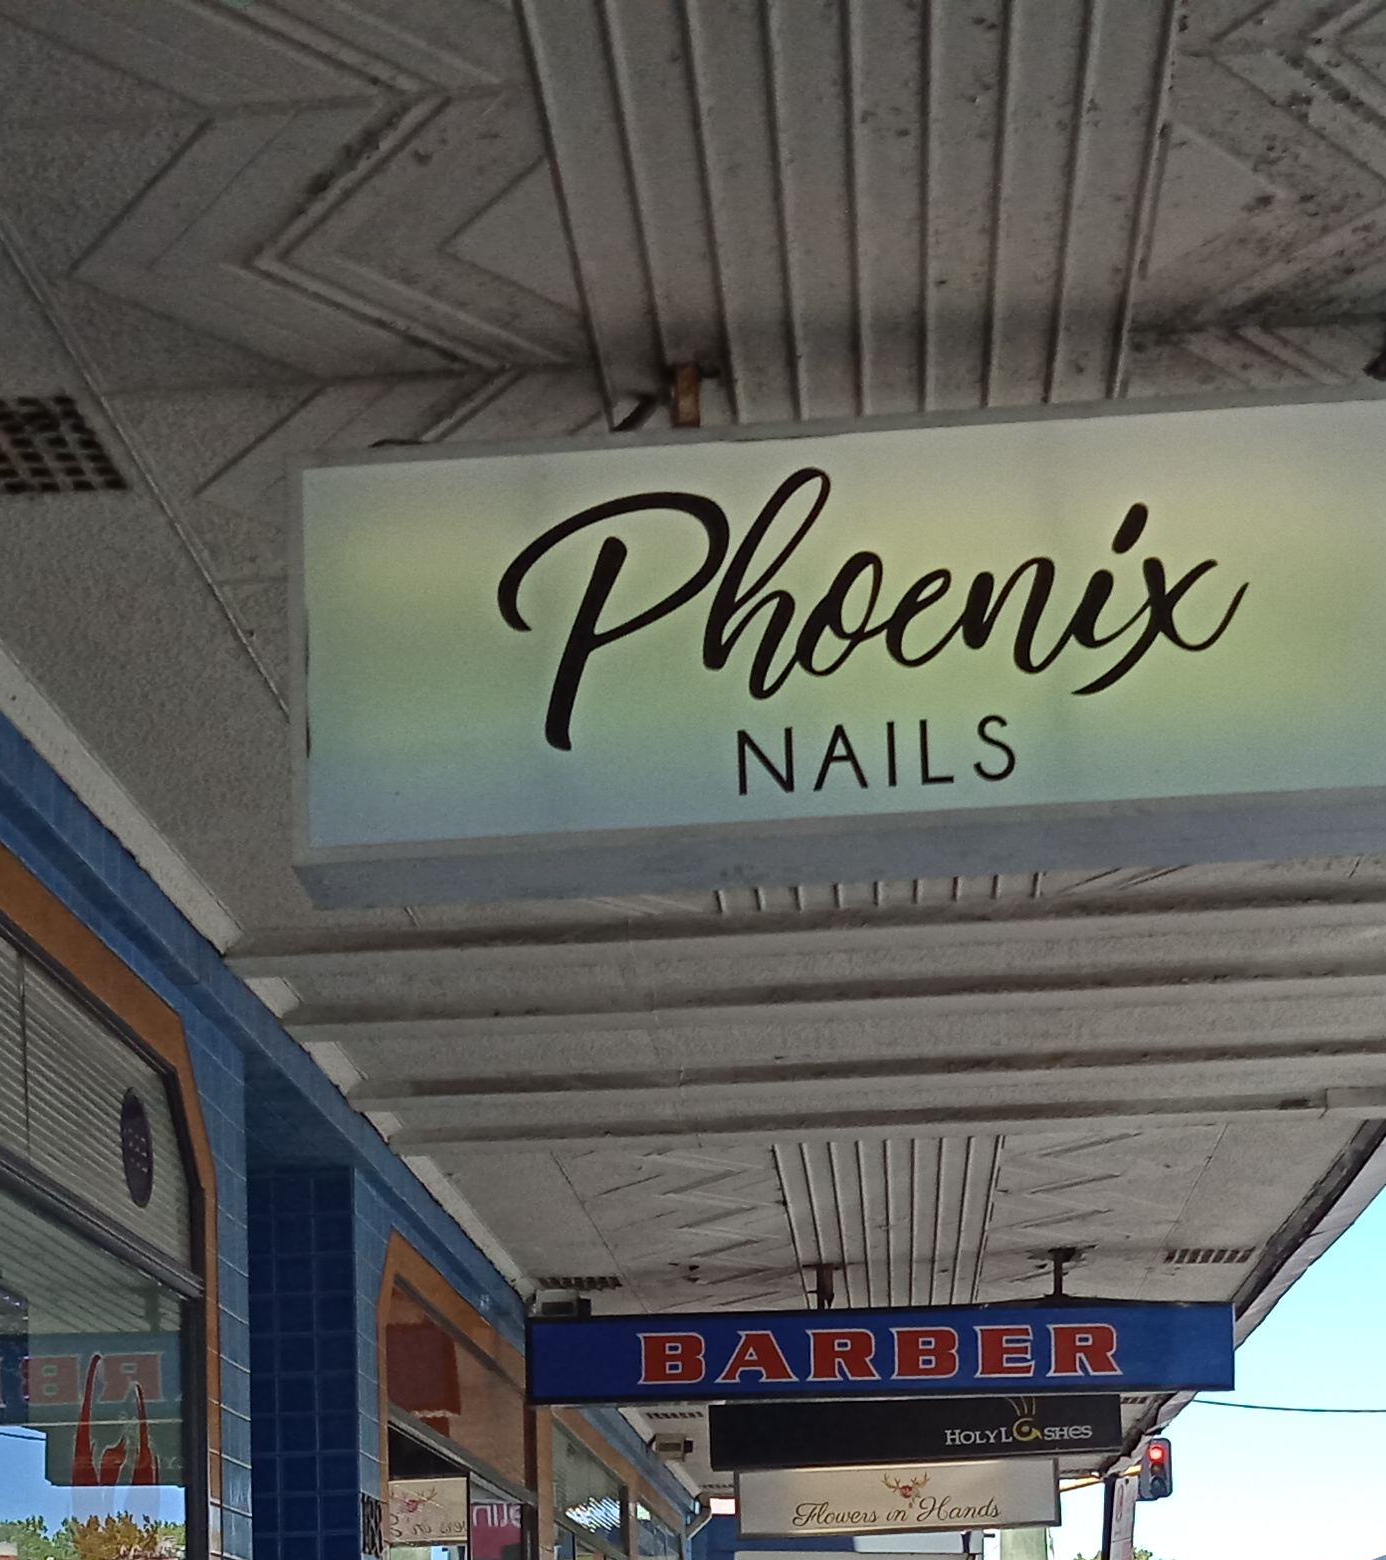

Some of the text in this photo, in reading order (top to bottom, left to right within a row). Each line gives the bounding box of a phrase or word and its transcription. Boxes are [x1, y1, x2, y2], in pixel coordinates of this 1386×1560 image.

[498, 467, 1250, 751] Phoenix
[736, 714, 1018, 796] NAILS
[638, 1323, 1123, 1385] BARBER
[792, 1496, 1002, 1526] Flowers in Hands
